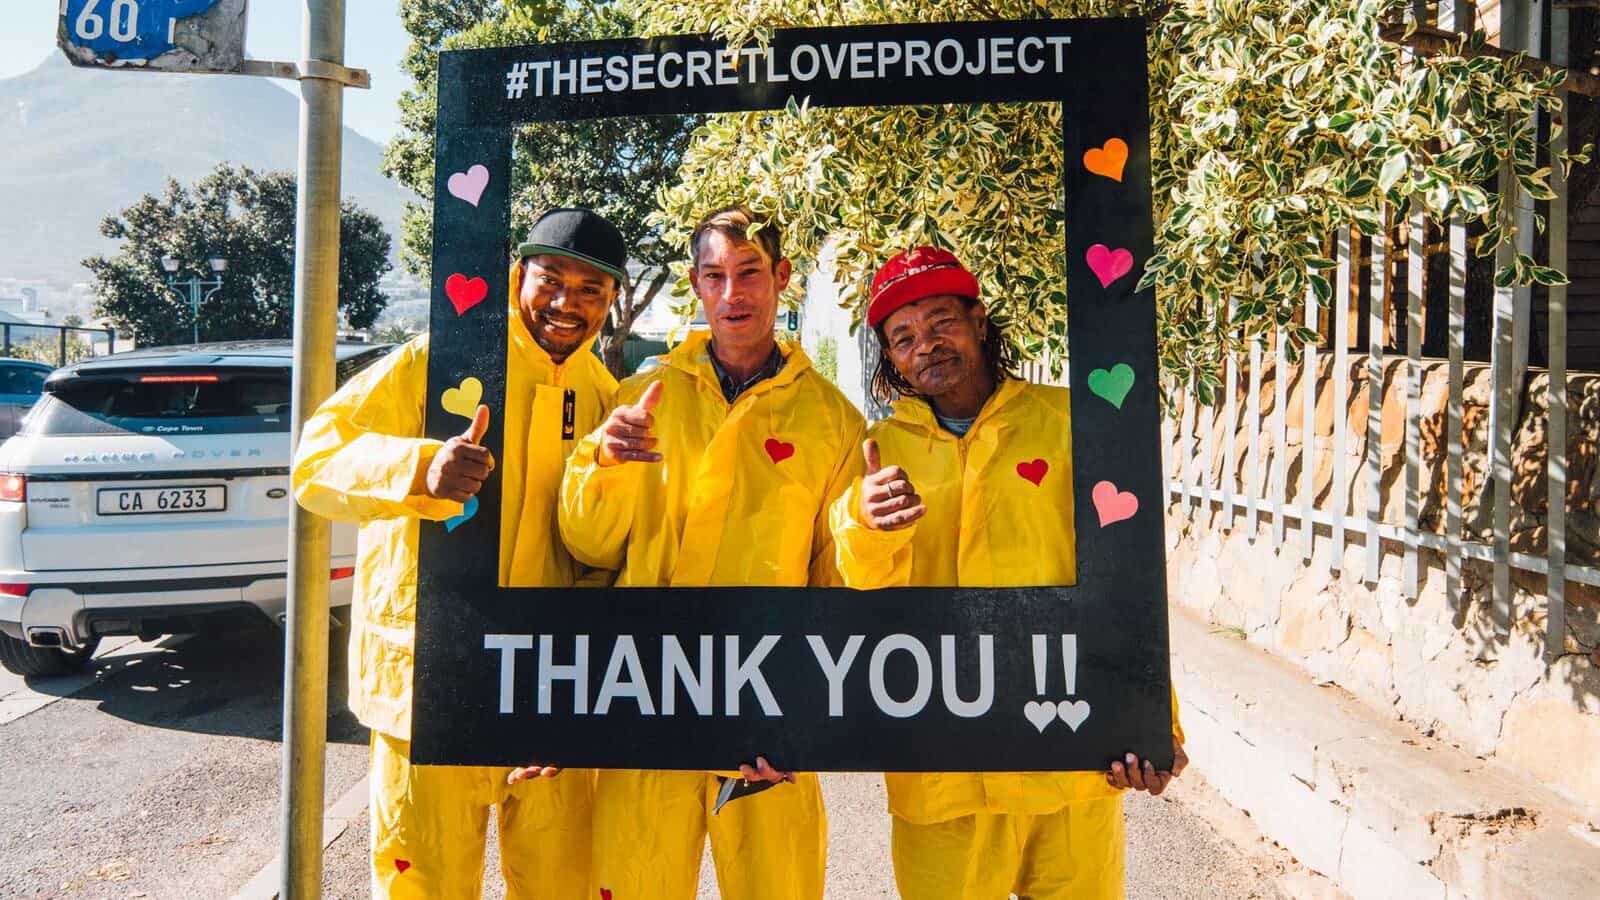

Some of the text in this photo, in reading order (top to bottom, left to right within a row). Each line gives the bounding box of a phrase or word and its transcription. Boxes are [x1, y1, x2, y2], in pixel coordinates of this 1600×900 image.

[75, 0, 139, 42] 60
[506, 36, 1072, 99] #THESECRETLOVEPROJECT
[156, 424, 204, 433] Cape Town
[118, 489, 207, 511] CA 6233
[484, 633, 784, 717] THANK
[807, 633, 995, 718] YOU
